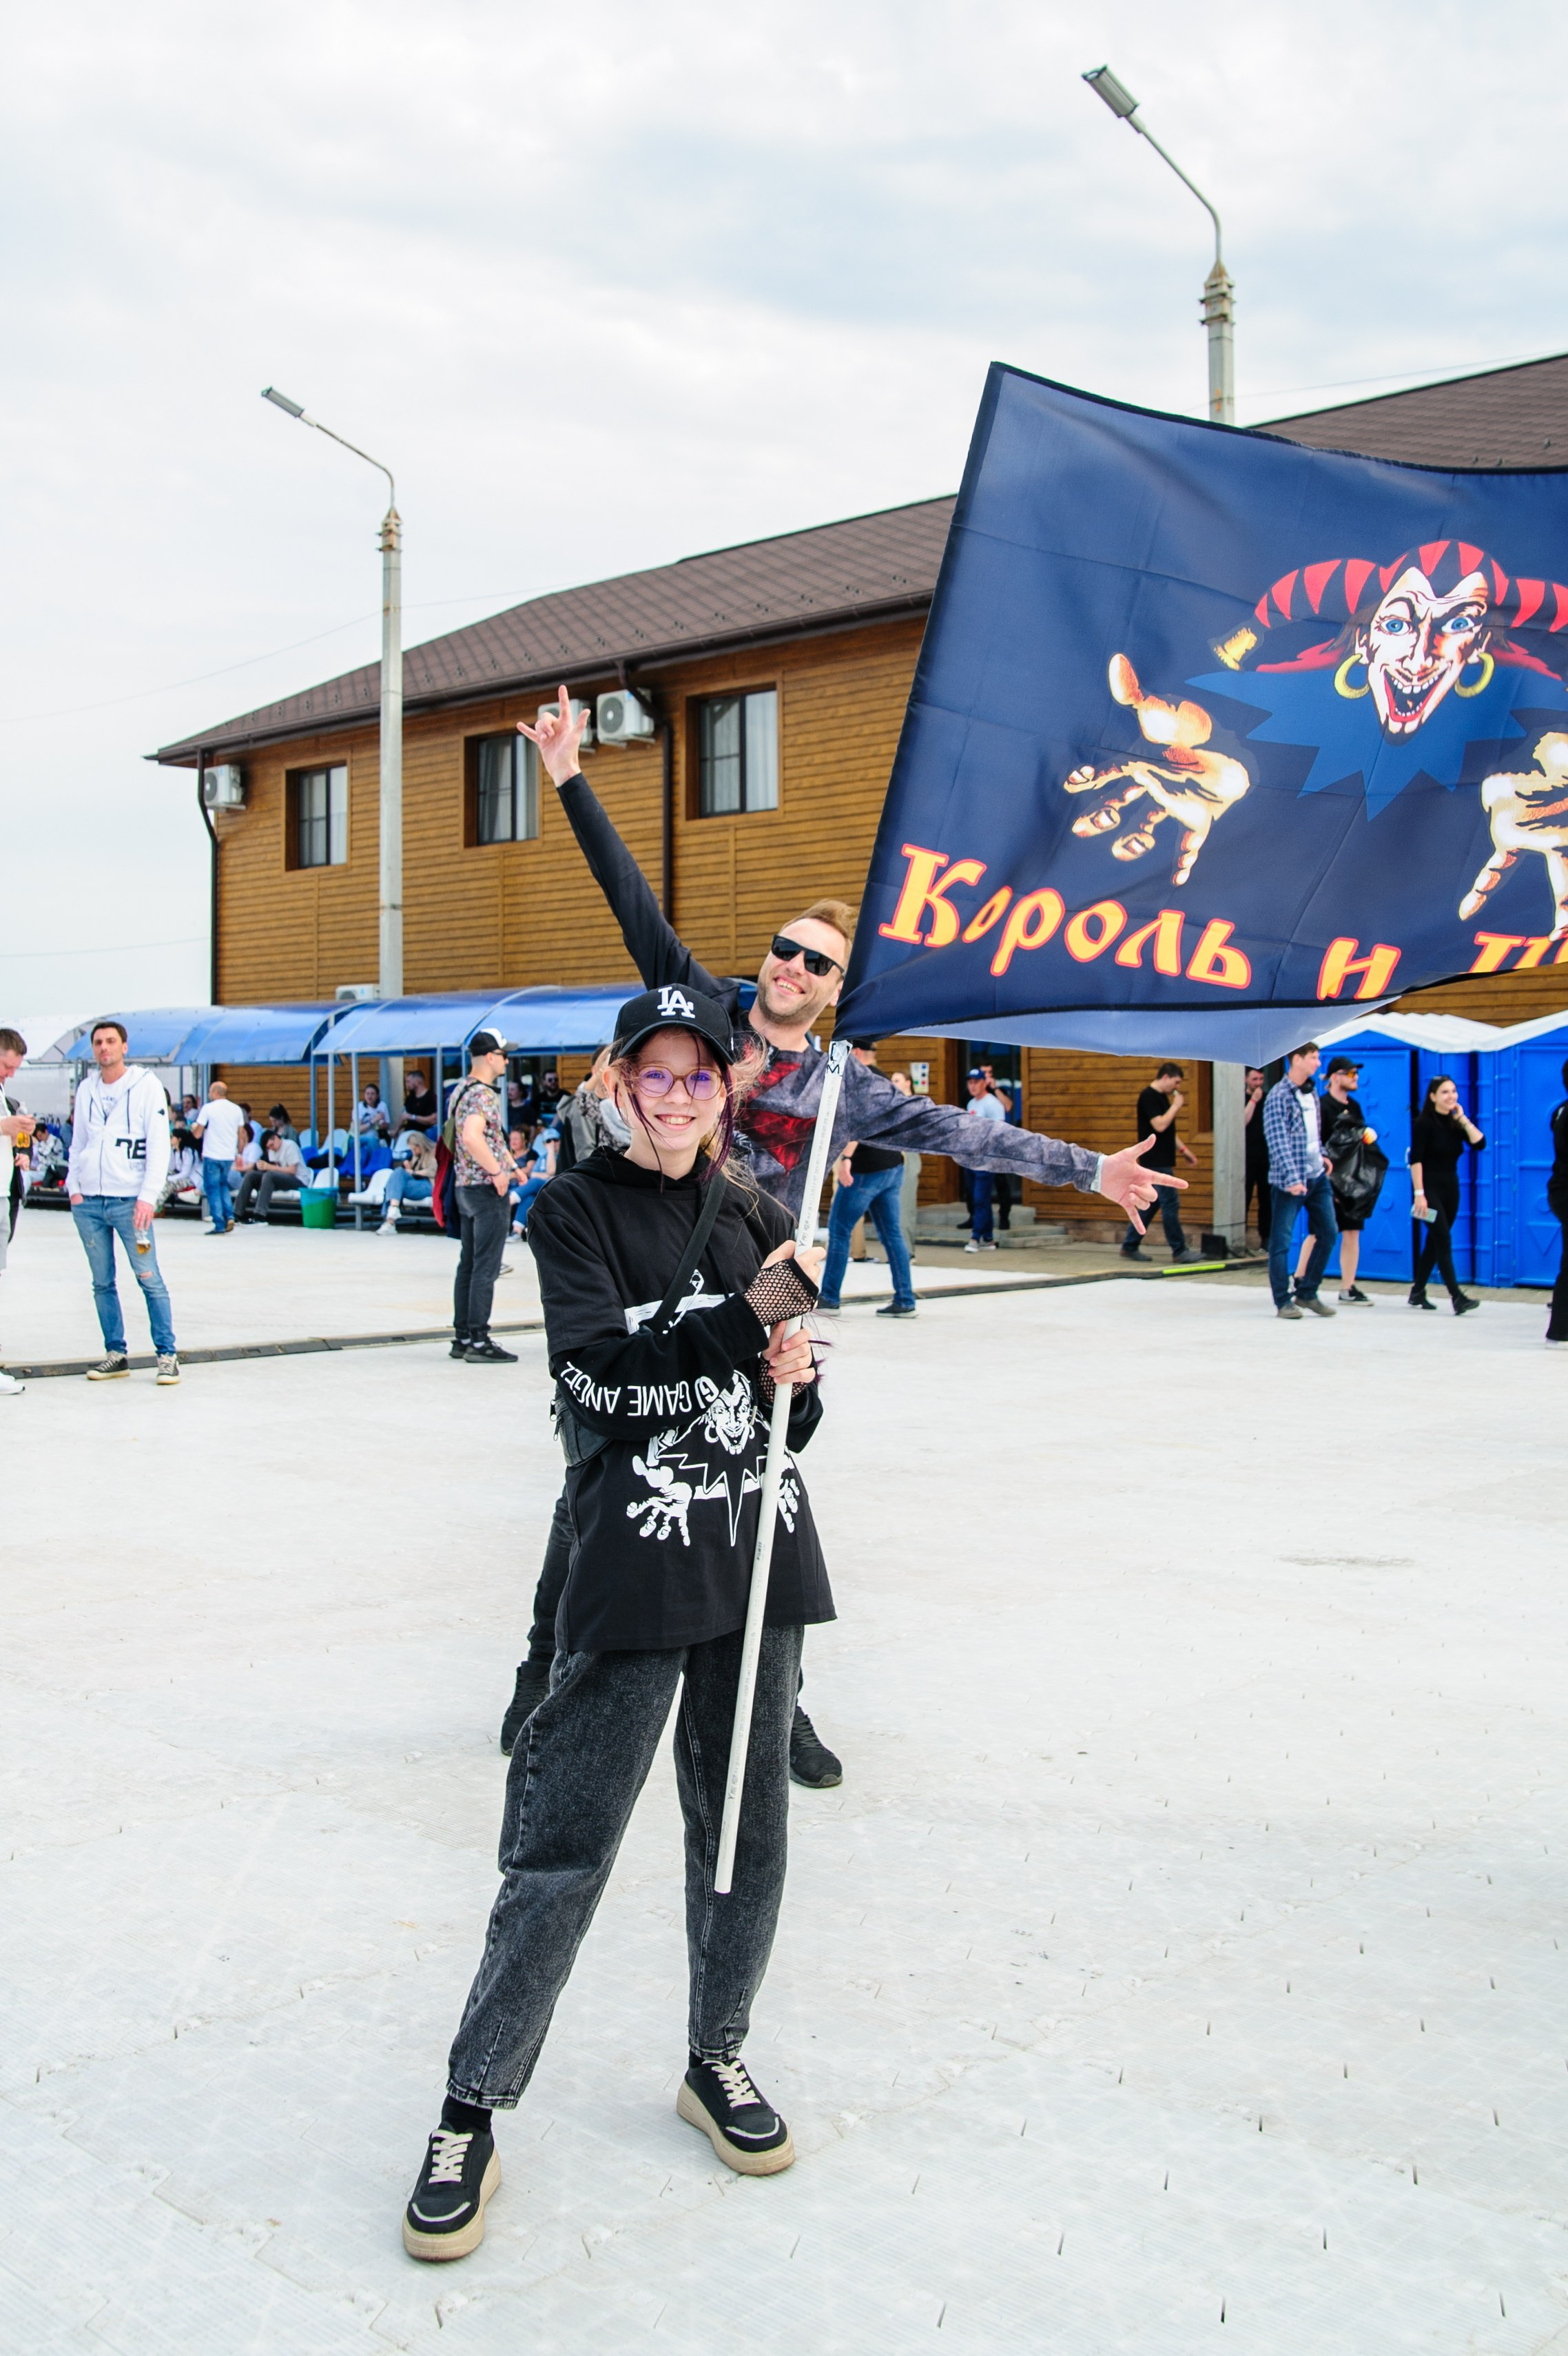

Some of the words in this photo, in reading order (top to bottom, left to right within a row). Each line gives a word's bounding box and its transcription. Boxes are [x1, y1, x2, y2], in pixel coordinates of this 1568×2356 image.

[879, 843, 1252, 990] Король
[657, 986, 695, 1018] LA
[560, 1361, 621, 1414] ANGEL
[627, 1381, 692, 1416] GAME
